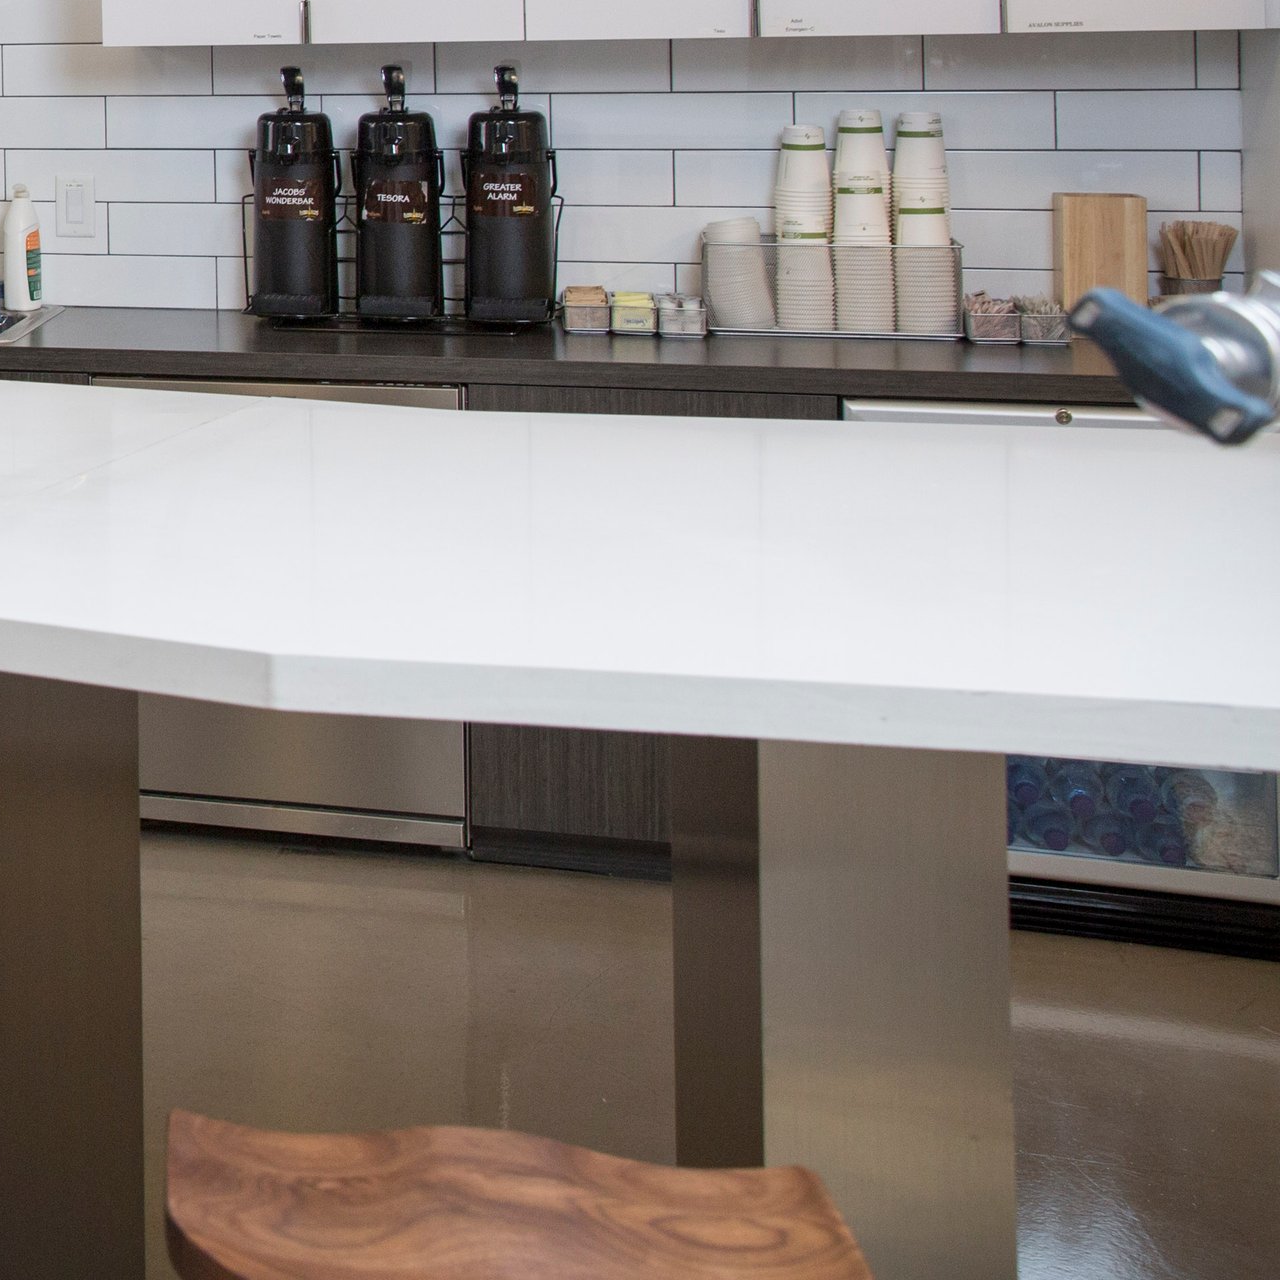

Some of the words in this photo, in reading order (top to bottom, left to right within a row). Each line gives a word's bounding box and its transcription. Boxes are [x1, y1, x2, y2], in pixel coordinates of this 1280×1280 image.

[483, 182, 523, 192] GREATER
[265, 196, 315, 205] WONDERBAR
[376, 193, 410, 203] TESORA
[487, 192, 518, 200] ALARM
